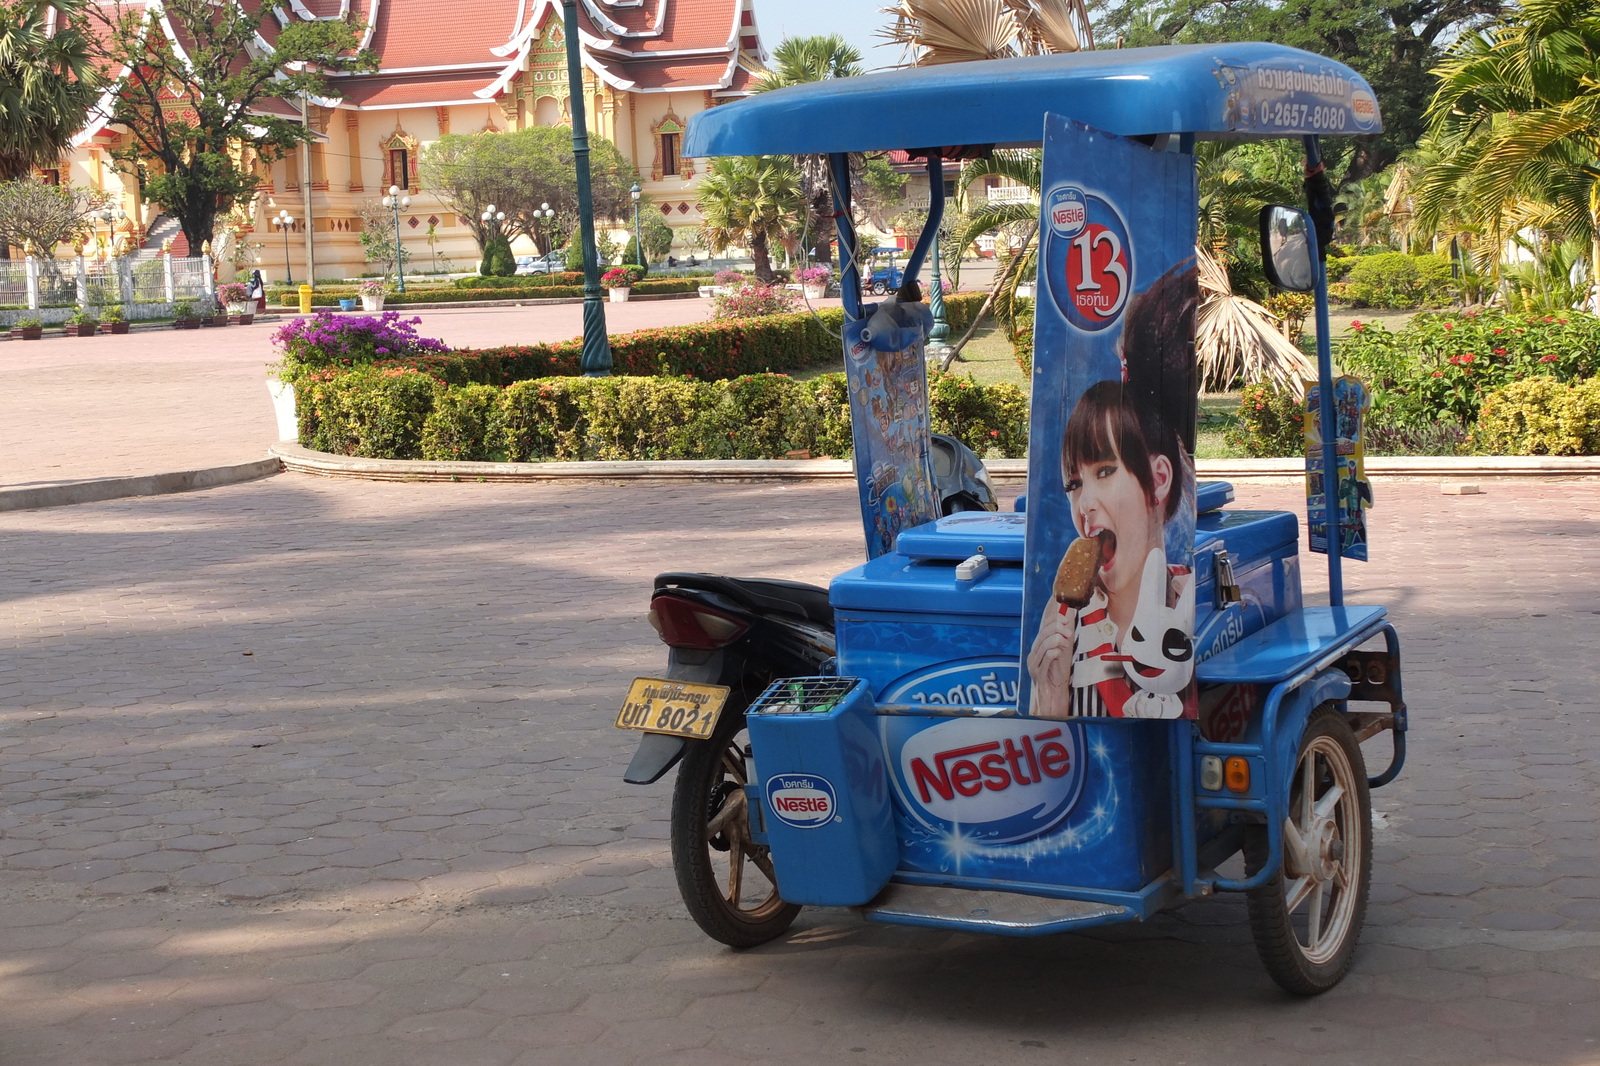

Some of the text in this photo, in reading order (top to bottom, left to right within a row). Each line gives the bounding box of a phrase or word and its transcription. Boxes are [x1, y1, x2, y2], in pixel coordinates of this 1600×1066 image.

[1261, 100, 1345, 130] 0-2657-8080
[1053, 207, 1084, 225] Nestlé
[1073, 230, 1128, 316] 13
[656, 706, 713, 734] 8021
[910, 728, 1070, 803] Nestlé
[779, 778, 814, 789] ไอศกรีม
[776, 797, 828, 812] Nestlé
